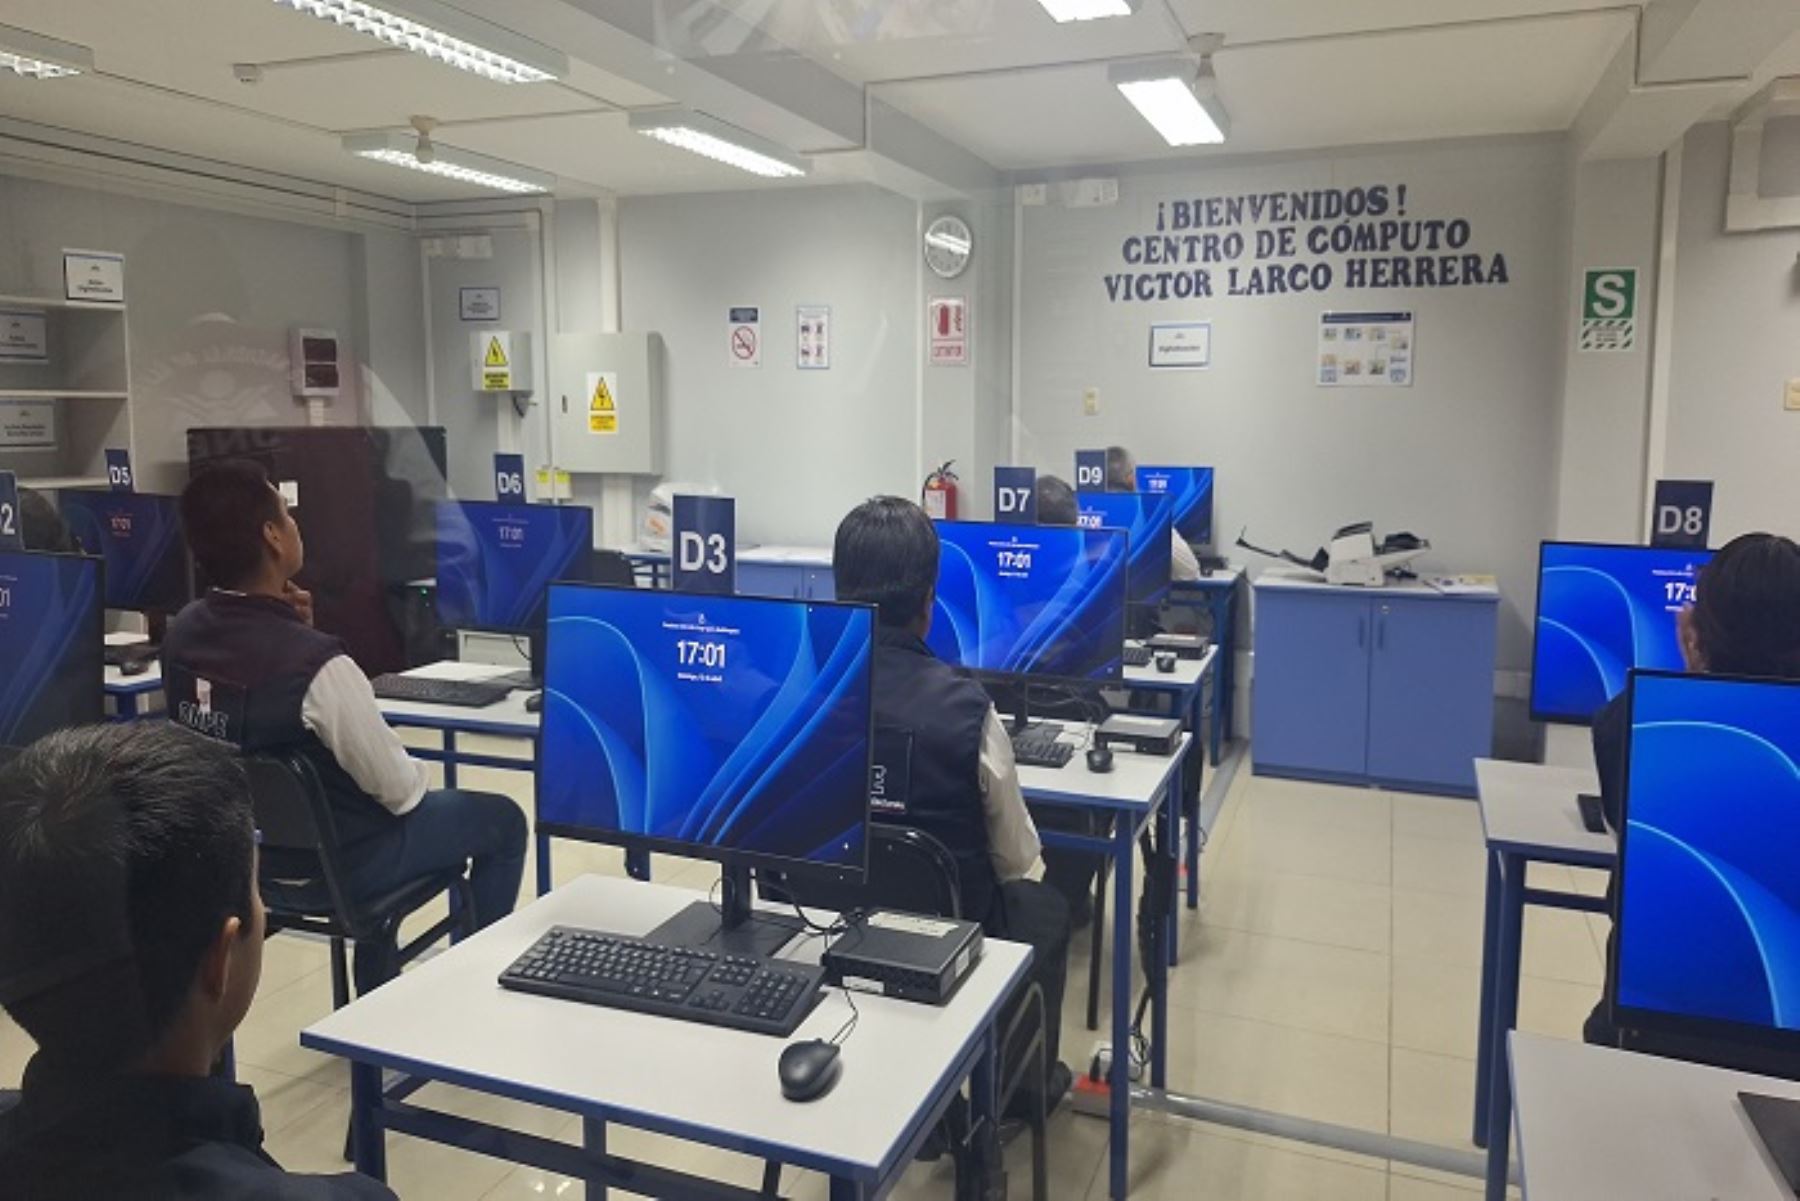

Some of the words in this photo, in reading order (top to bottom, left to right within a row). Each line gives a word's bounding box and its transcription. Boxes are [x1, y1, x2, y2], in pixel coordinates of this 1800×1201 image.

[1122, 232, 1244, 264] CENTRO
[1256, 227, 1296, 260] DE
[1307, 217, 1472, 257] CÓMPUTO
[1104, 269, 1213, 301] VICTOR
[1228, 263, 1333, 297] LARCO
[1344, 252, 1511, 289] HERRERA
[1592, 273, 1626, 317] S
[110, 465, 131, 485] D5
[497, 471, 522, 495] D6
[1078, 465, 1103, 486] D9
[998, 487, 1031, 513] D7
[1657, 505, 1703, 535] D8
[680, 531, 728, 574] D3
[677, 640, 726, 669] 17:01
